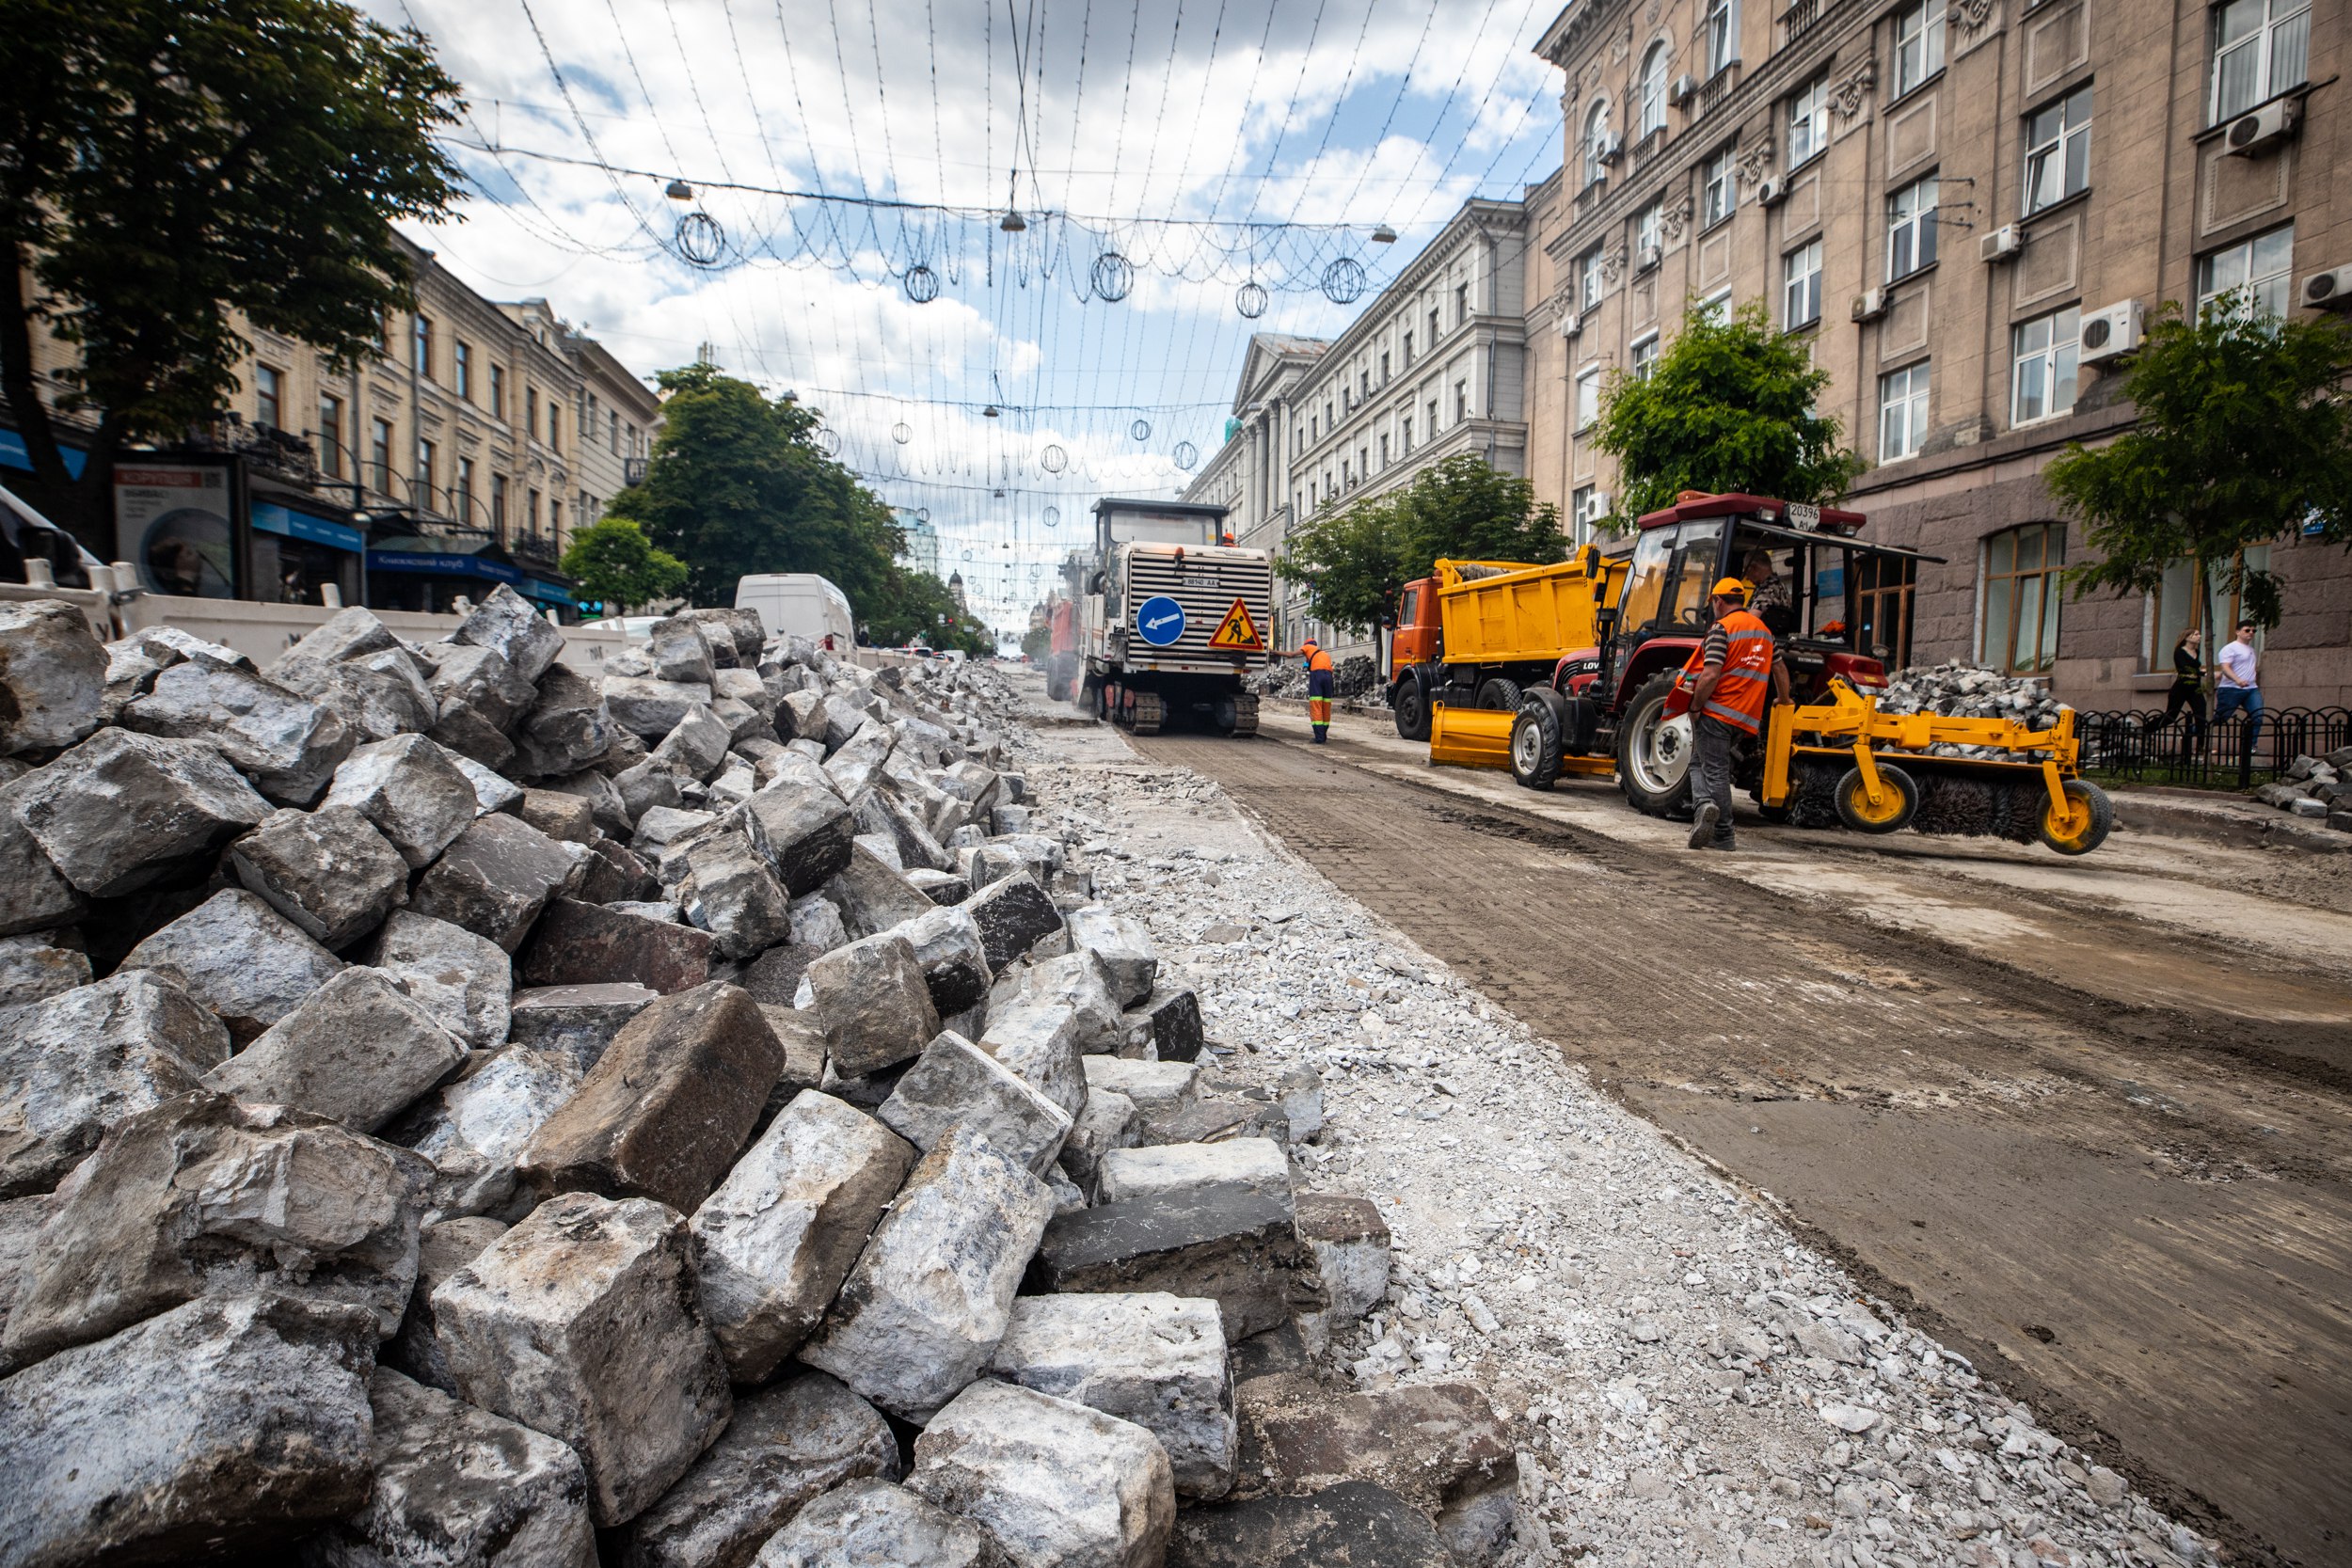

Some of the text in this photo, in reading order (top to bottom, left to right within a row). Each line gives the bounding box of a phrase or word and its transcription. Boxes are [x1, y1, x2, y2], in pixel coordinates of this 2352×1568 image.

[1790, 504, 1819, 519] 20396
[439, 560, 465, 570] клуб
[1582, 661, 1599, 670] LOV
